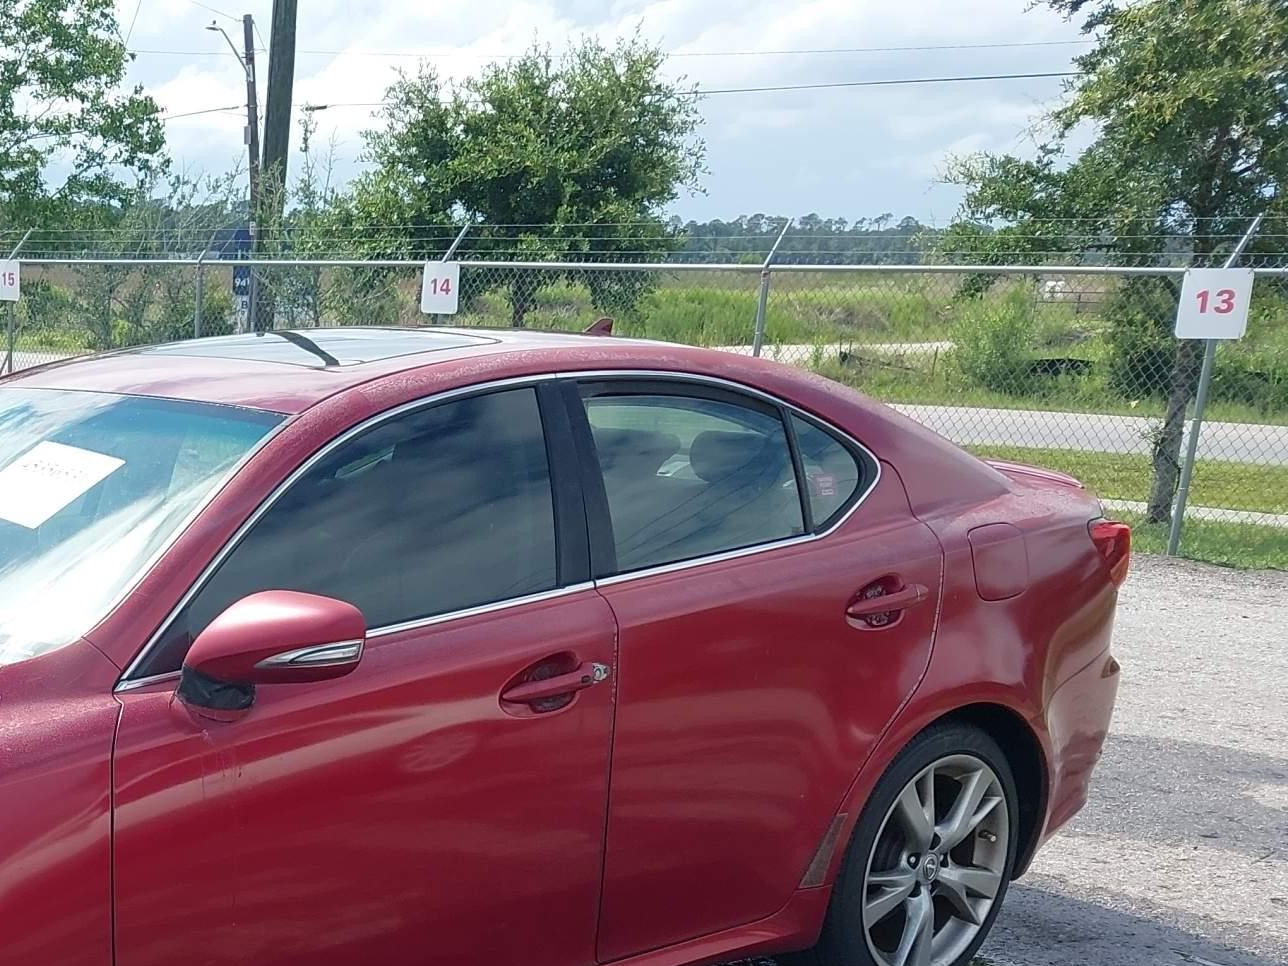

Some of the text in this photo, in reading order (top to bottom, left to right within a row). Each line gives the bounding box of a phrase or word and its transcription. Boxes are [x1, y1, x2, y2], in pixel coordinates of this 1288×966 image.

[2, 272, 15, 286] 15
[431, 278, 451, 295] 14
[1196, 289, 1236, 314] 13
